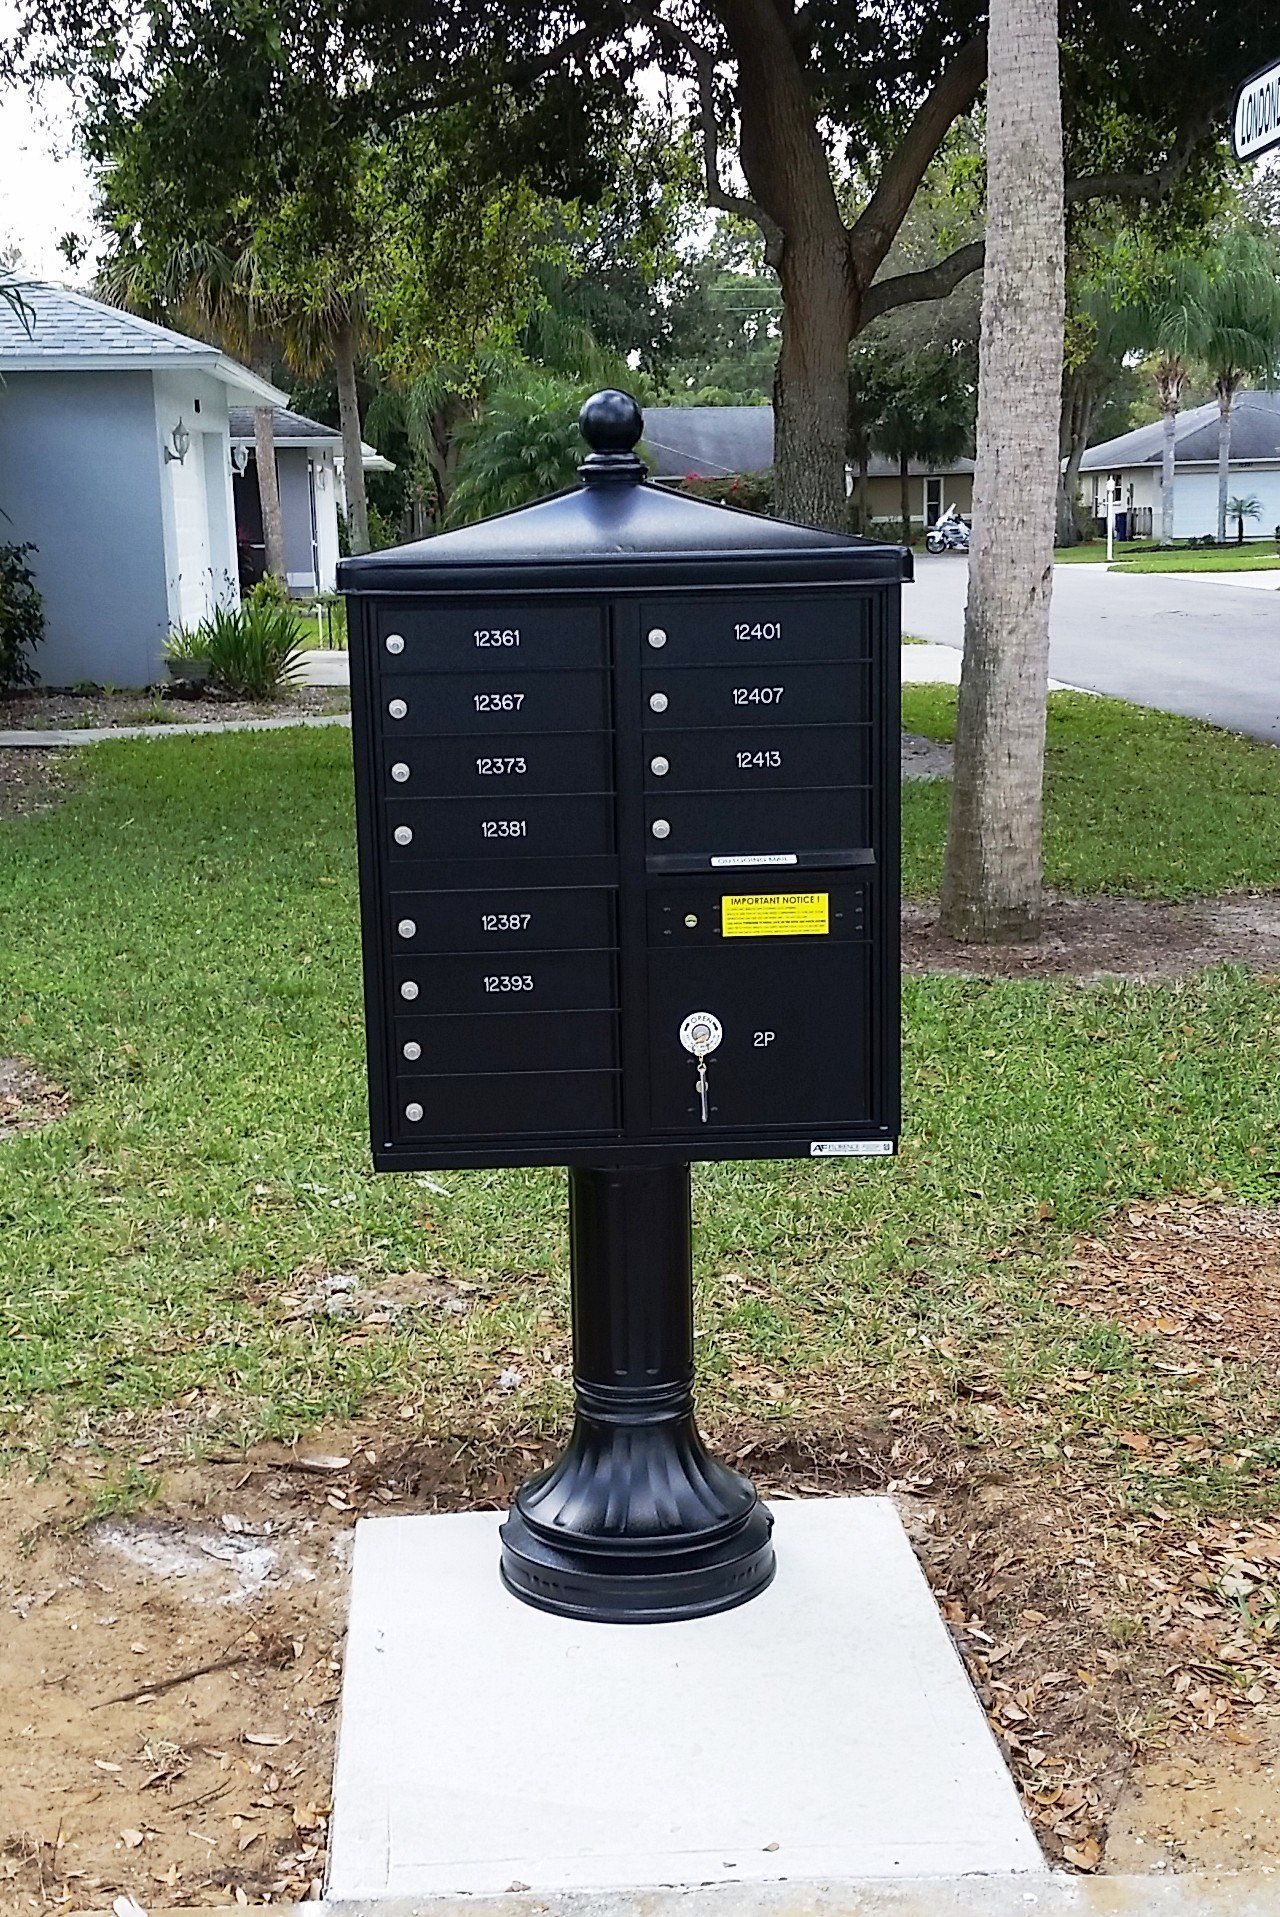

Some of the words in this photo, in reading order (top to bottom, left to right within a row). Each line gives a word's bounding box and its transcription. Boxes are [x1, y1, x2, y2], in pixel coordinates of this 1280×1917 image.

[474, 630, 520, 646] 12361
[734, 623, 781, 640] 12401
[473, 694, 524, 711] 12367
[733, 688, 784, 704] 12407
[476, 758, 527, 774] 12373
[736, 751, 782, 767] 12413
[481, 821, 527, 837] 12381
[731, 897, 780, 905] IMPORTANT
[782, 895, 814, 904] NOTICE
[481, 914, 532, 930] 12387
[484, 976, 534, 992] 12393
[690, 1015, 713, 1024] OPEN
[753, 1032, 775, 1047] 2P
